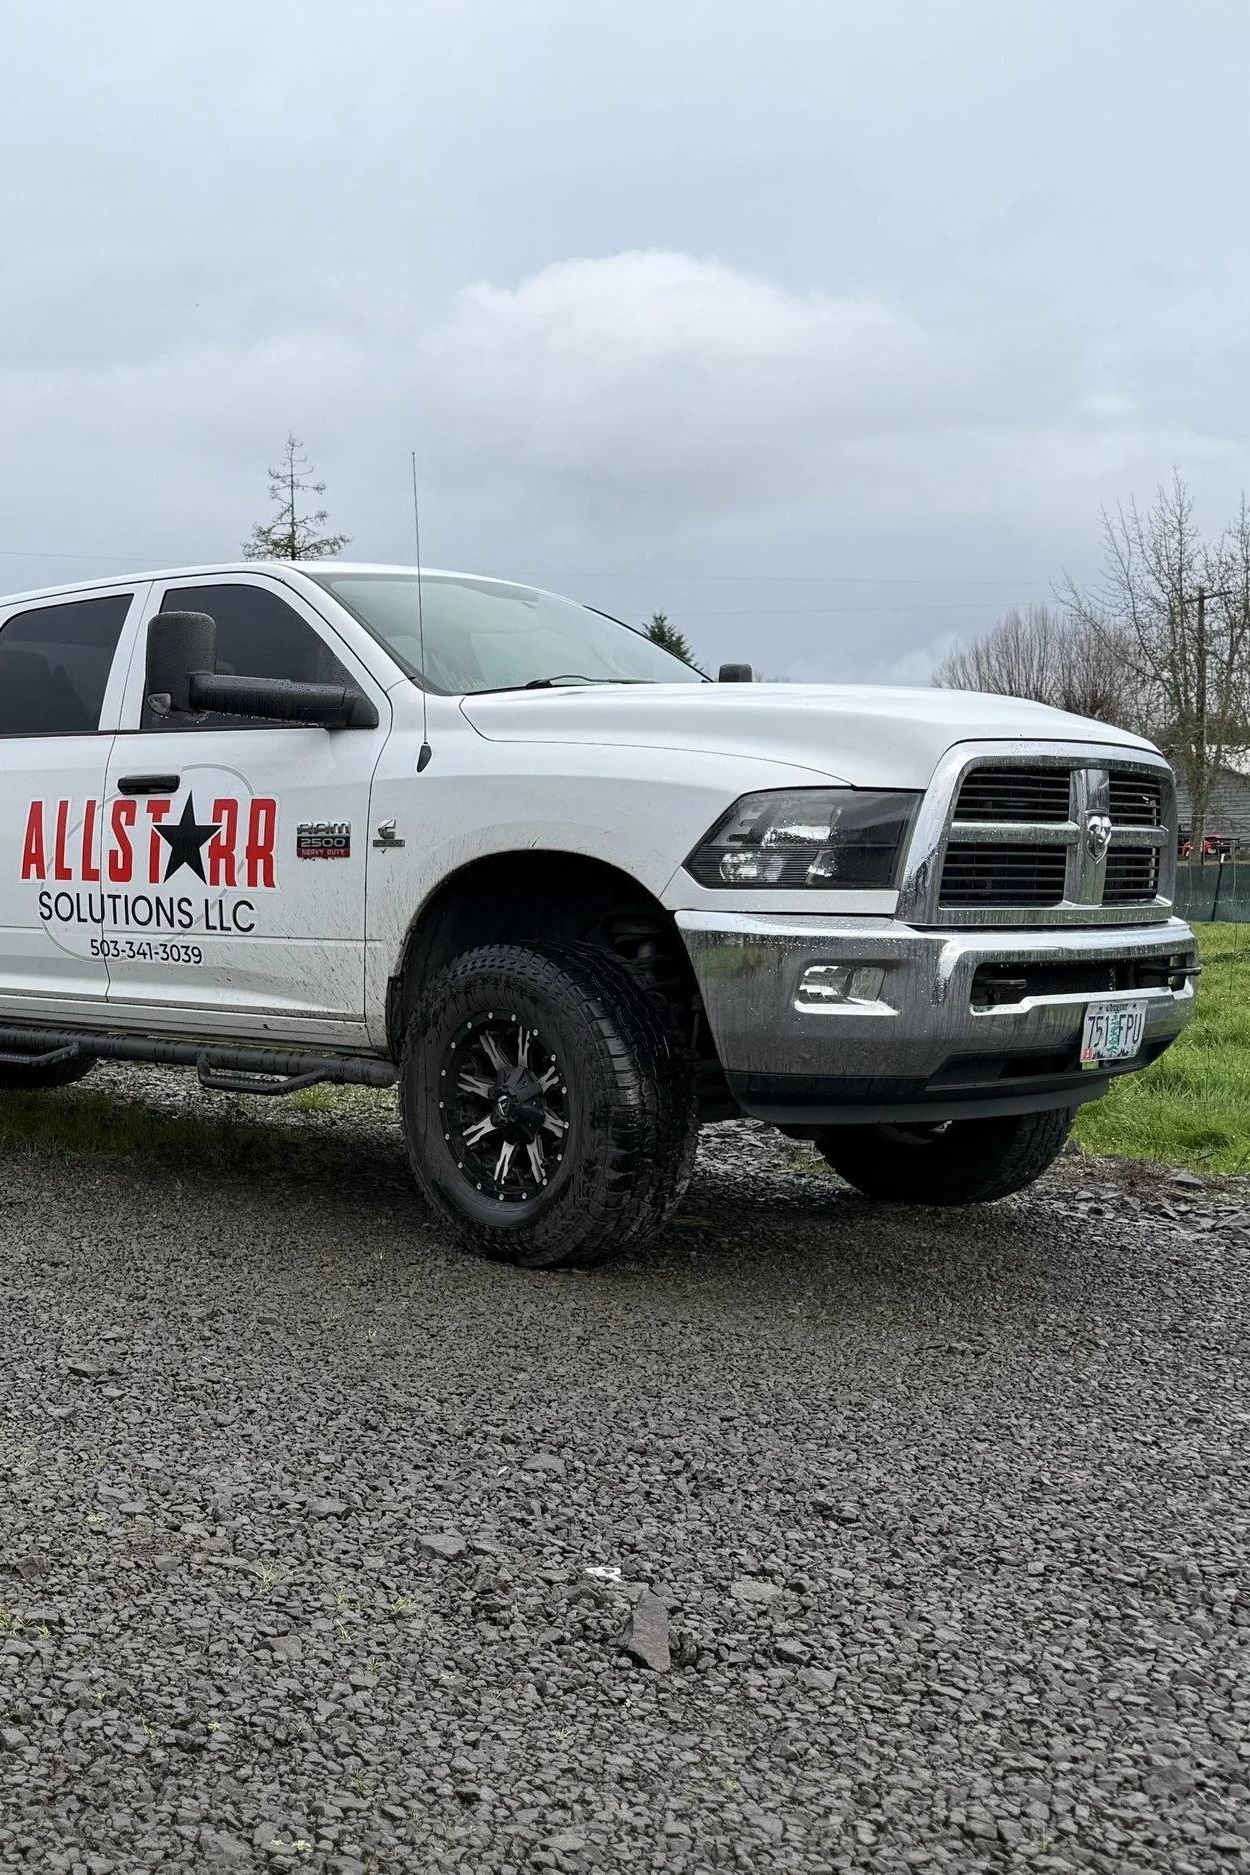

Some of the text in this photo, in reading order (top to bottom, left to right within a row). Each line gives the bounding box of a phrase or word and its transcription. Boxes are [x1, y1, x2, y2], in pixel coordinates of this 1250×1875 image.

[21, 790, 277, 889] ALLSTRR
[296, 821, 351, 835] RAM
[300, 838, 346, 848] 2500
[301, 848, 346, 856] HEAVY DUTY
[38, 890, 256, 933] SOLUTIONS LLC
[90, 938, 204, 965] 503-341-3039
[1088, 1013, 1143, 1049] 751 FPU
